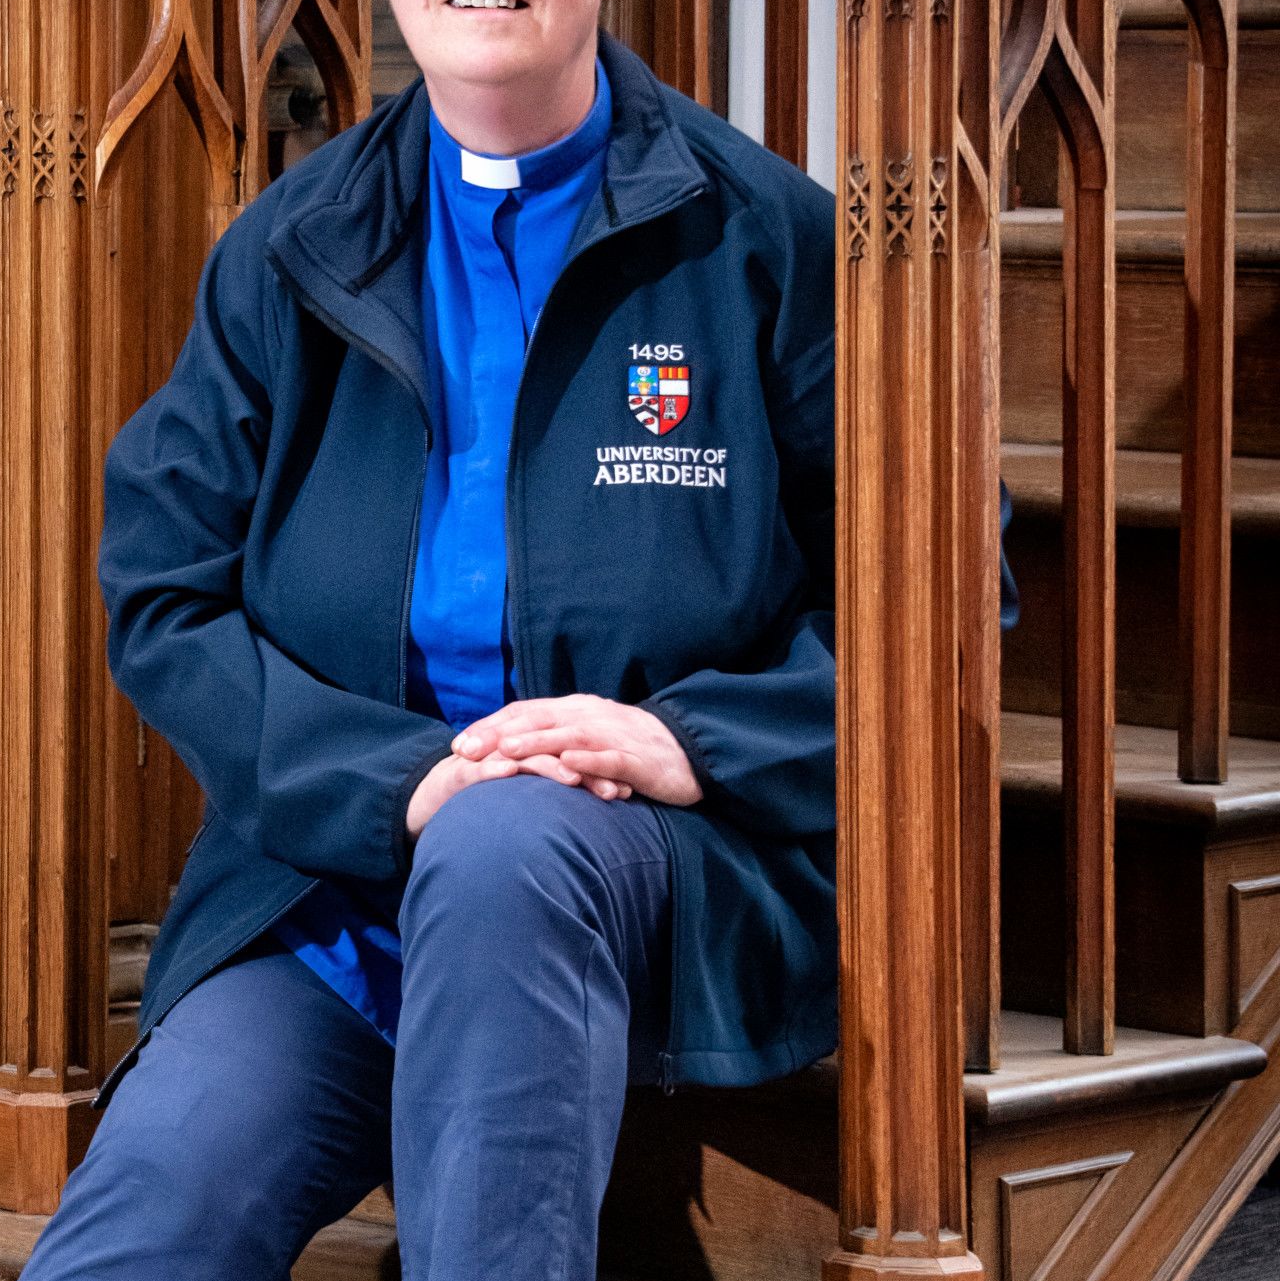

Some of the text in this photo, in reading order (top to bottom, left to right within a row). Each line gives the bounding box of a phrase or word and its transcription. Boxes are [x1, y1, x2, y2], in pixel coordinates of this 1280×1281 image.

[628, 344, 683, 361] 1495
[596, 447, 727, 465] UNIVERSITY OF
[593, 464, 727, 488] ABERDEEN
